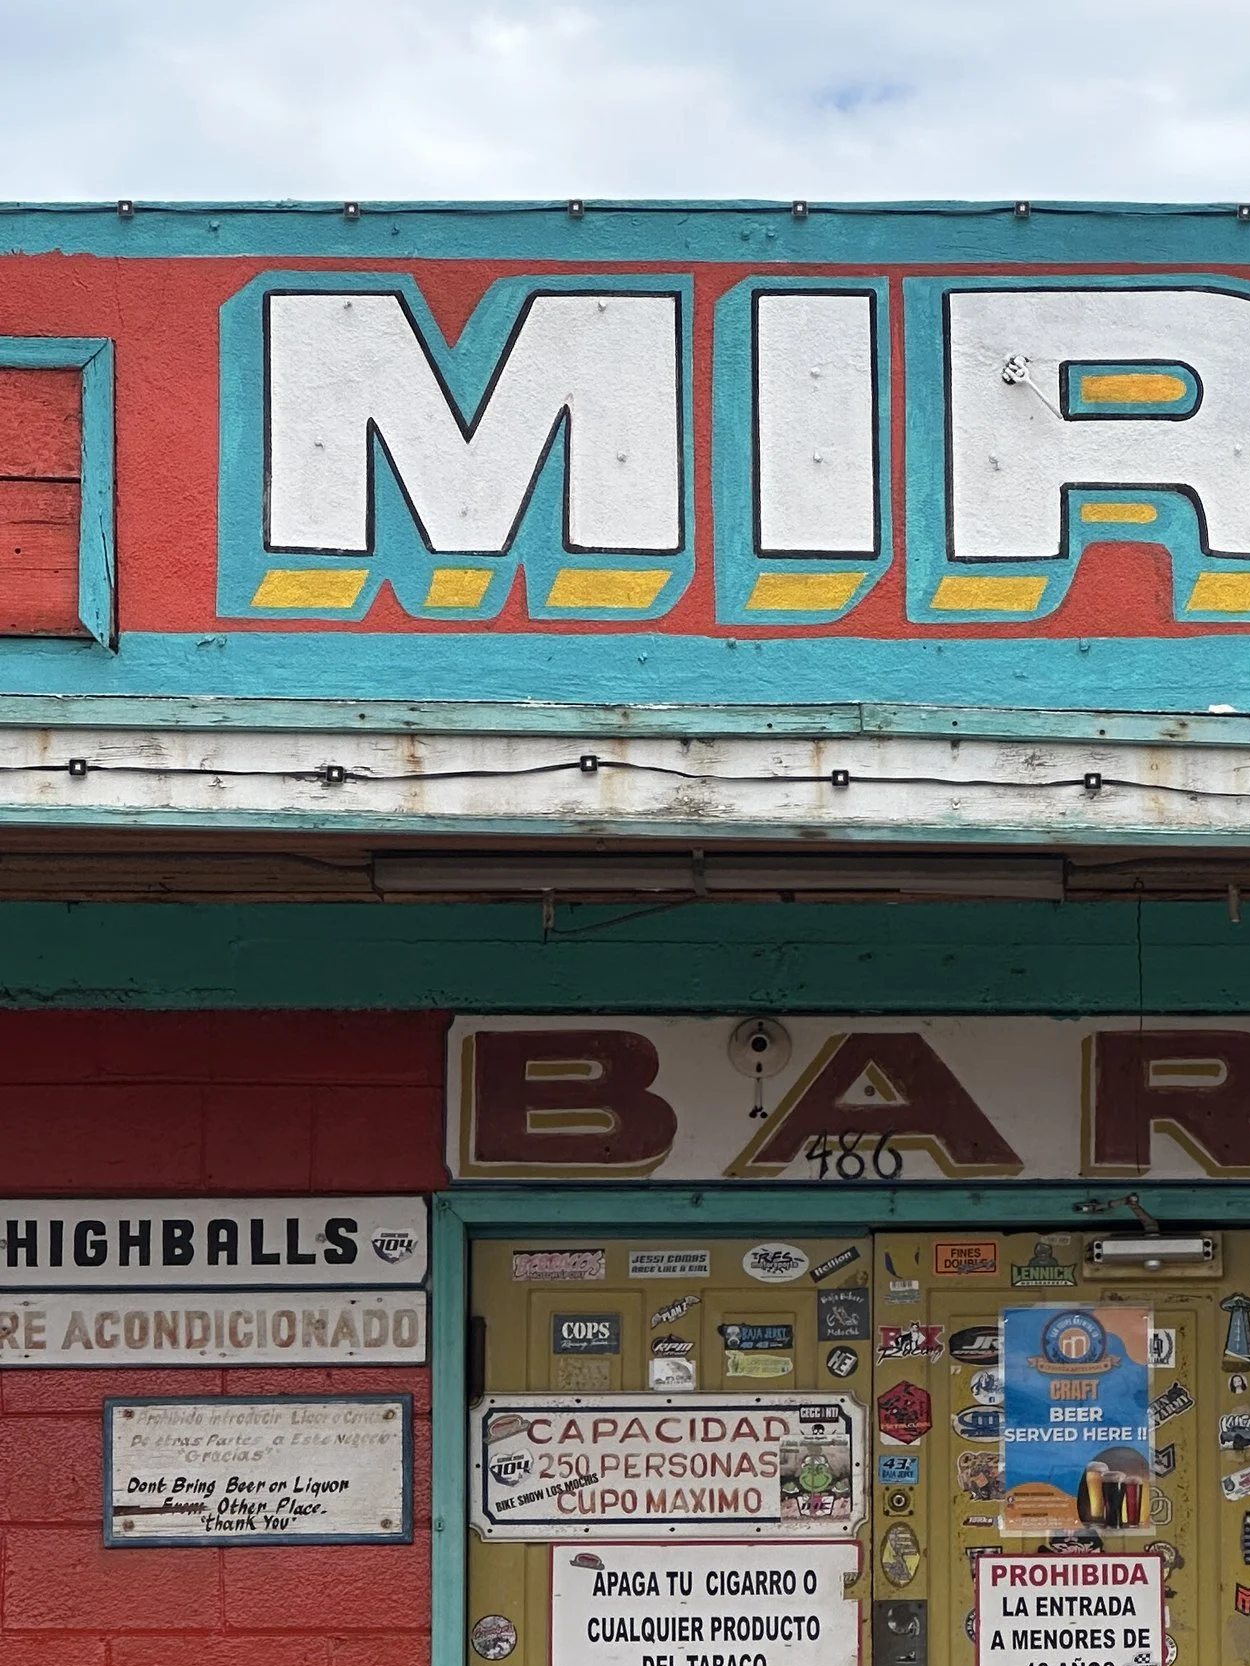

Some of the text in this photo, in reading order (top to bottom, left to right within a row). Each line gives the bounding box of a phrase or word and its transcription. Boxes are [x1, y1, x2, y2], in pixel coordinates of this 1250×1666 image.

[804, 1127, 903, 1180] 486
[6, 1217, 358, 1266] HIGHBALLS
[951, 1248, 981, 1258] FINES
[631, 1254, 707, 1264] JESSI COMBS
[814, 1250, 852, 1277] Hellion
[1012, 1265, 1075, 1283] LENNICK
[61, 1308, 418, 1351] ACONDICIONADO
[562, 1322, 610, 1339] COPS
[1050, 1379, 1099, 1400] CRAFT
[1049, 1407, 1103, 1422] BEER
[526, 1416, 791, 1445] CAPACIDAD
[1004, 1428, 1078, 1442] SERVED
[1083, 1427, 1132, 1441] HERE
[538, 1450, 778, 1480] 250 PERSONAS
[127, 1475, 349, 1498] Dont Bring Beer or Liquor
[495, 1497, 516, 1513] BIKE
[517, 1490, 544, 1506] SHOW
[545, 1483, 563, 1498] LOS
[217, 1498, 267, 1515] Other
[556, 1487, 762, 1515] CUPO MAXIMO
[592, 1569, 817, 1597] APAGA TU CIGARRO O
[991, 1563, 1149, 1587] PROHIBIDA
[1002, 1596, 1136, 1617] LA ENTRADA
[587, 1616, 820, 1644] CUALQUIER PRODUCTO
[991, 1628, 1150, 1650] A MENORES DE
